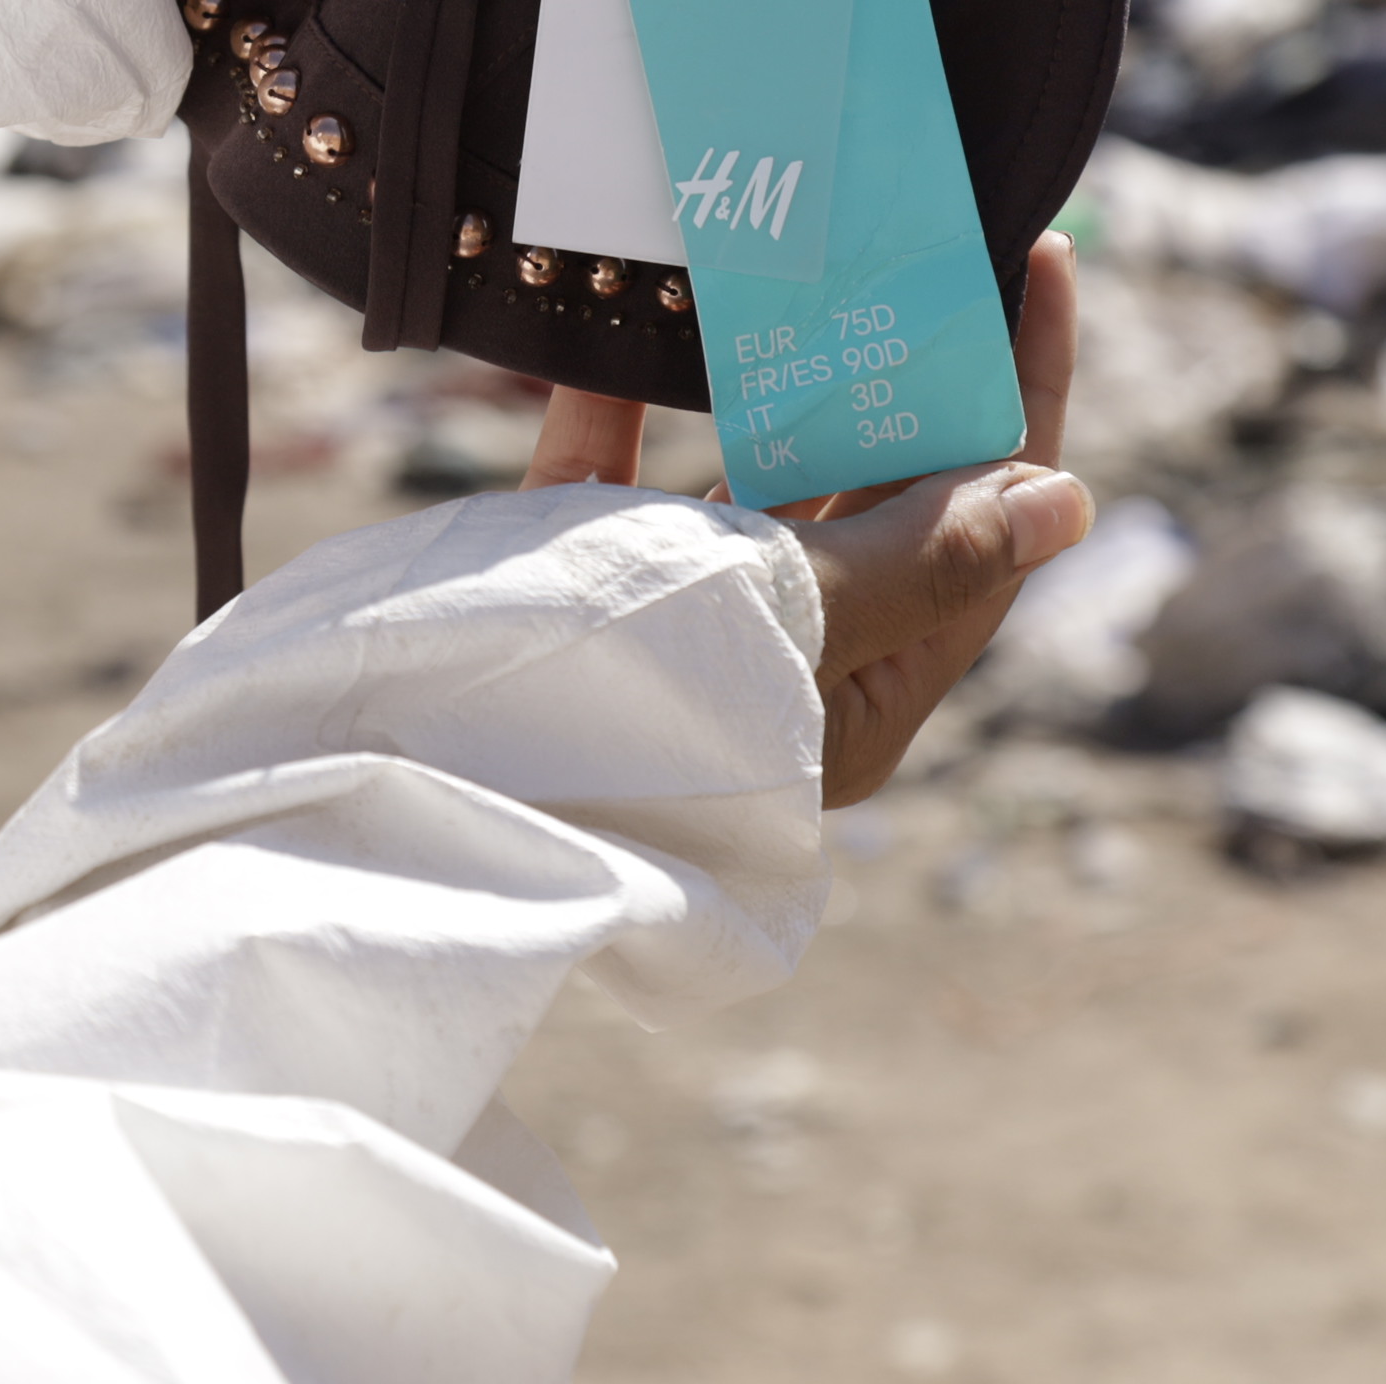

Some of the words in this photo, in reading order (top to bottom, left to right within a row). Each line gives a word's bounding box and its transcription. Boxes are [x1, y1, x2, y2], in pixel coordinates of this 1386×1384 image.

[671, 146, 804, 242] H&M
[735, 325, 797, 365] EUR
[831, 303, 896, 341] 75D
[740, 354, 833, 401] FR/ES
[841, 337, 909, 375] 90D
[746, 403, 775, 435] IT
[850, 378, 894, 413] 3D
[753, 436, 801, 471] UK
[856, 411, 920, 450] 34D
